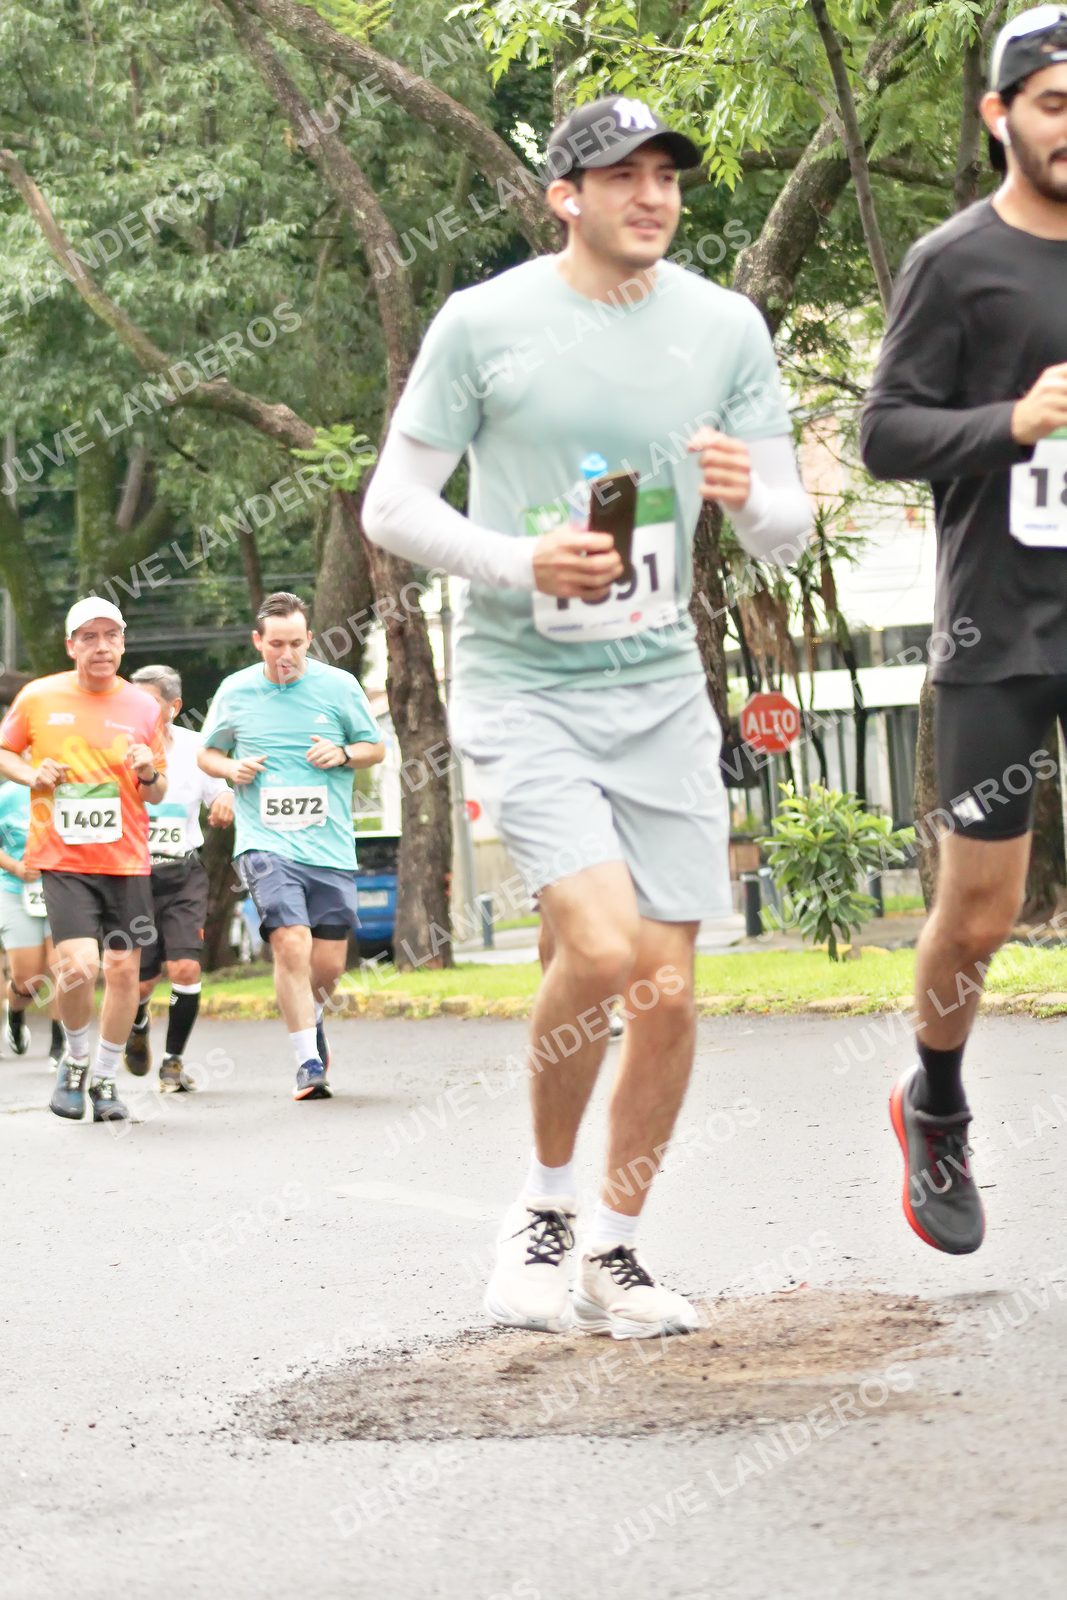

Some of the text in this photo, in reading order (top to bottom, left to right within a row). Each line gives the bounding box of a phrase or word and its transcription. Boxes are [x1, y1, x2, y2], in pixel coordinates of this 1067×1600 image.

[746, 709, 796, 736] ALTO
[266, 797, 323, 816] 5872
[61, 810, 117, 828] 1402
